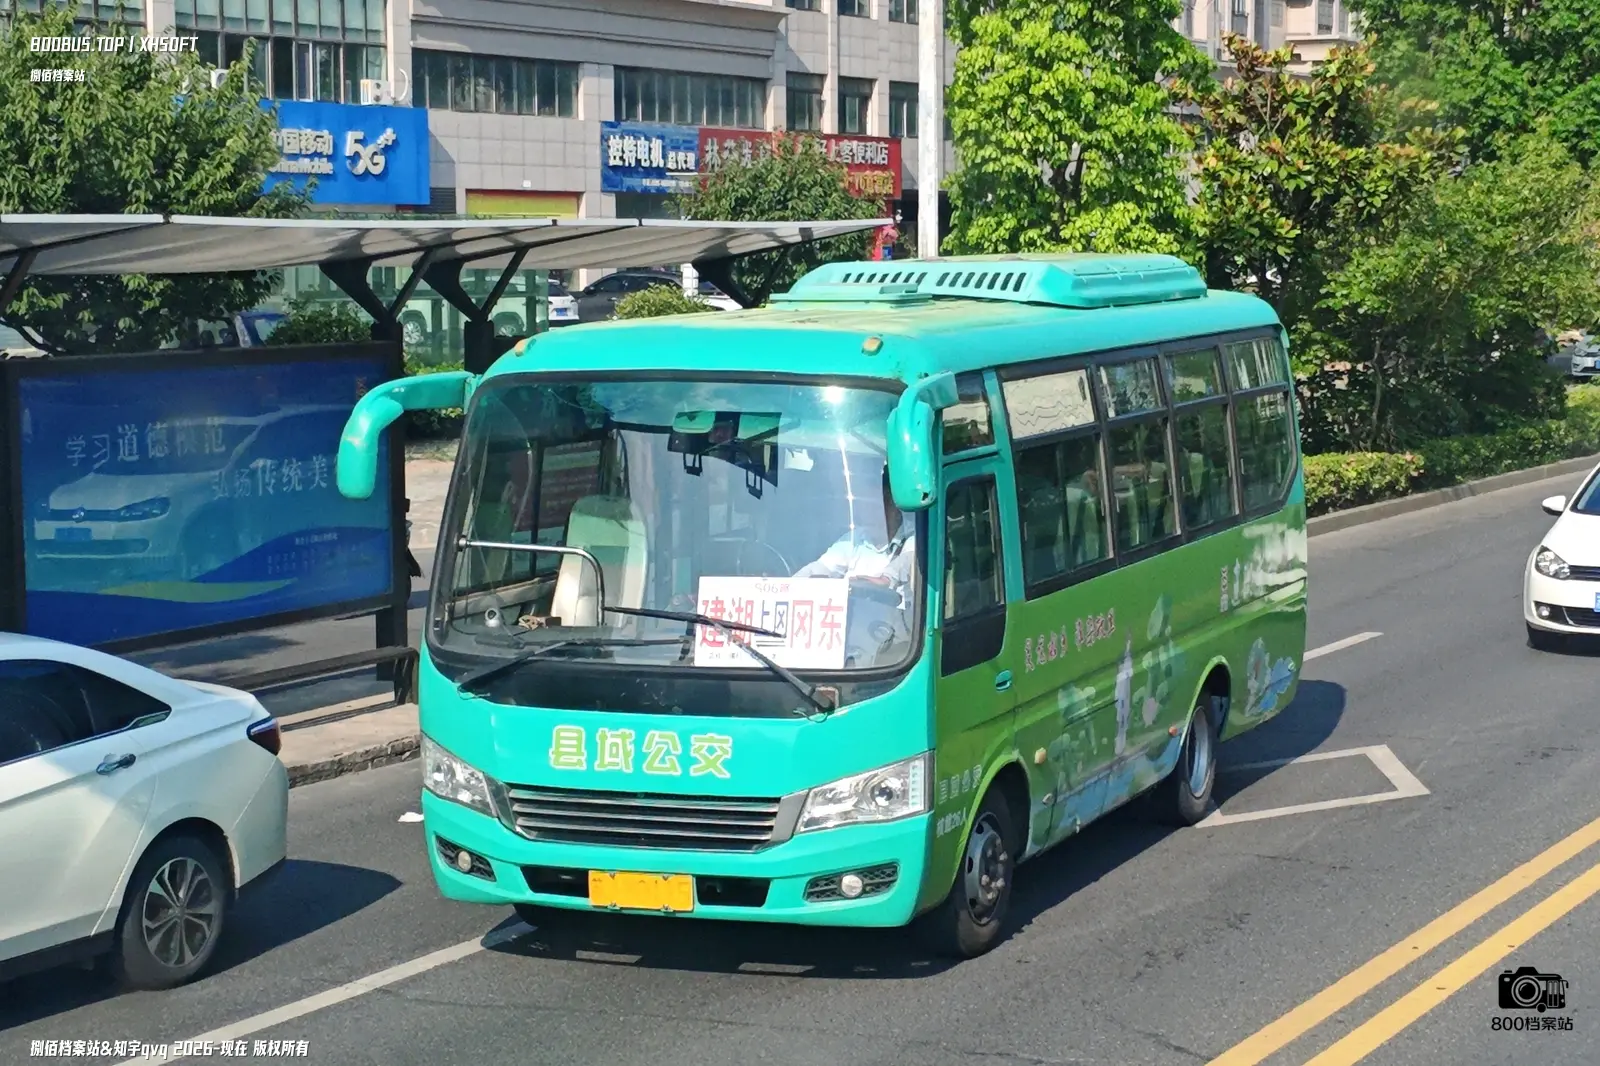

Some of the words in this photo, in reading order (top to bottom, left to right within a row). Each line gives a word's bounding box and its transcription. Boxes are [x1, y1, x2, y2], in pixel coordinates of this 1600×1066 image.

[211, 454, 337, 499] 弘扬传统美
[549, 725, 732, 779] 县域公交
